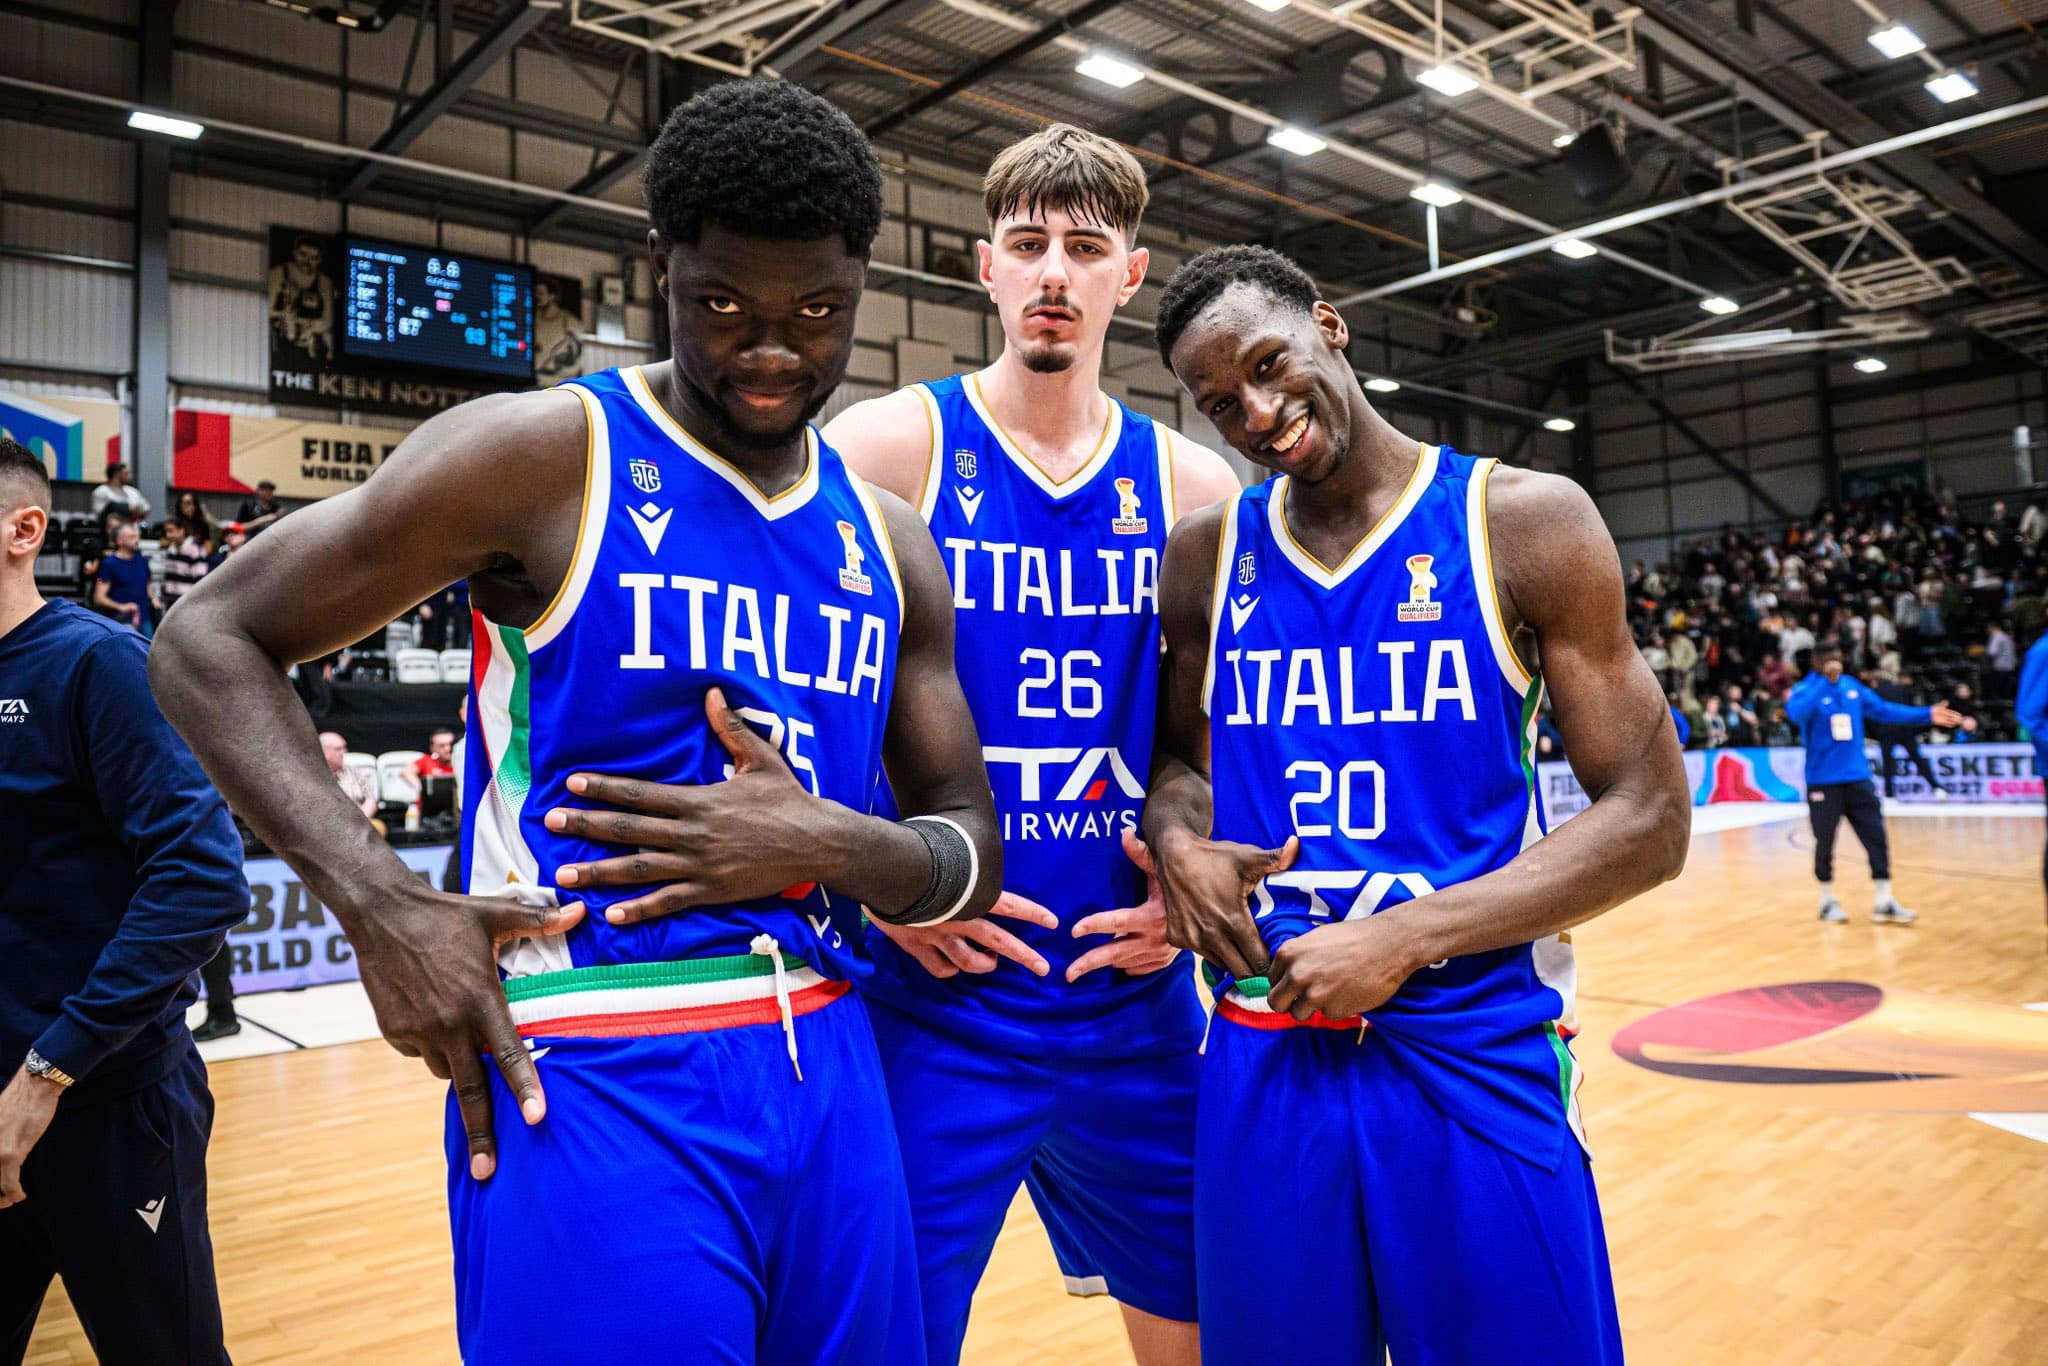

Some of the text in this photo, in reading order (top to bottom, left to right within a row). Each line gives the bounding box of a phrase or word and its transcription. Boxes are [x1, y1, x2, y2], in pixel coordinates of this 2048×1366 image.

[272, 370, 479, 407] THE KEN NOTT
[301, 464, 368, 482] WORLD
[302, 438, 372, 464] FIBA
[945, 537, 1159, 617] ITALIA
[619, 573, 886, 704] ITALIA
[1400, 612, 1440, 620] QUALIFIERS
[1017, 647, 1103, 718] 26
[1226, 639, 1478, 727] ITALIA
[982, 746, 1147, 801] TA
[1284, 760, 1386, 840] 20
